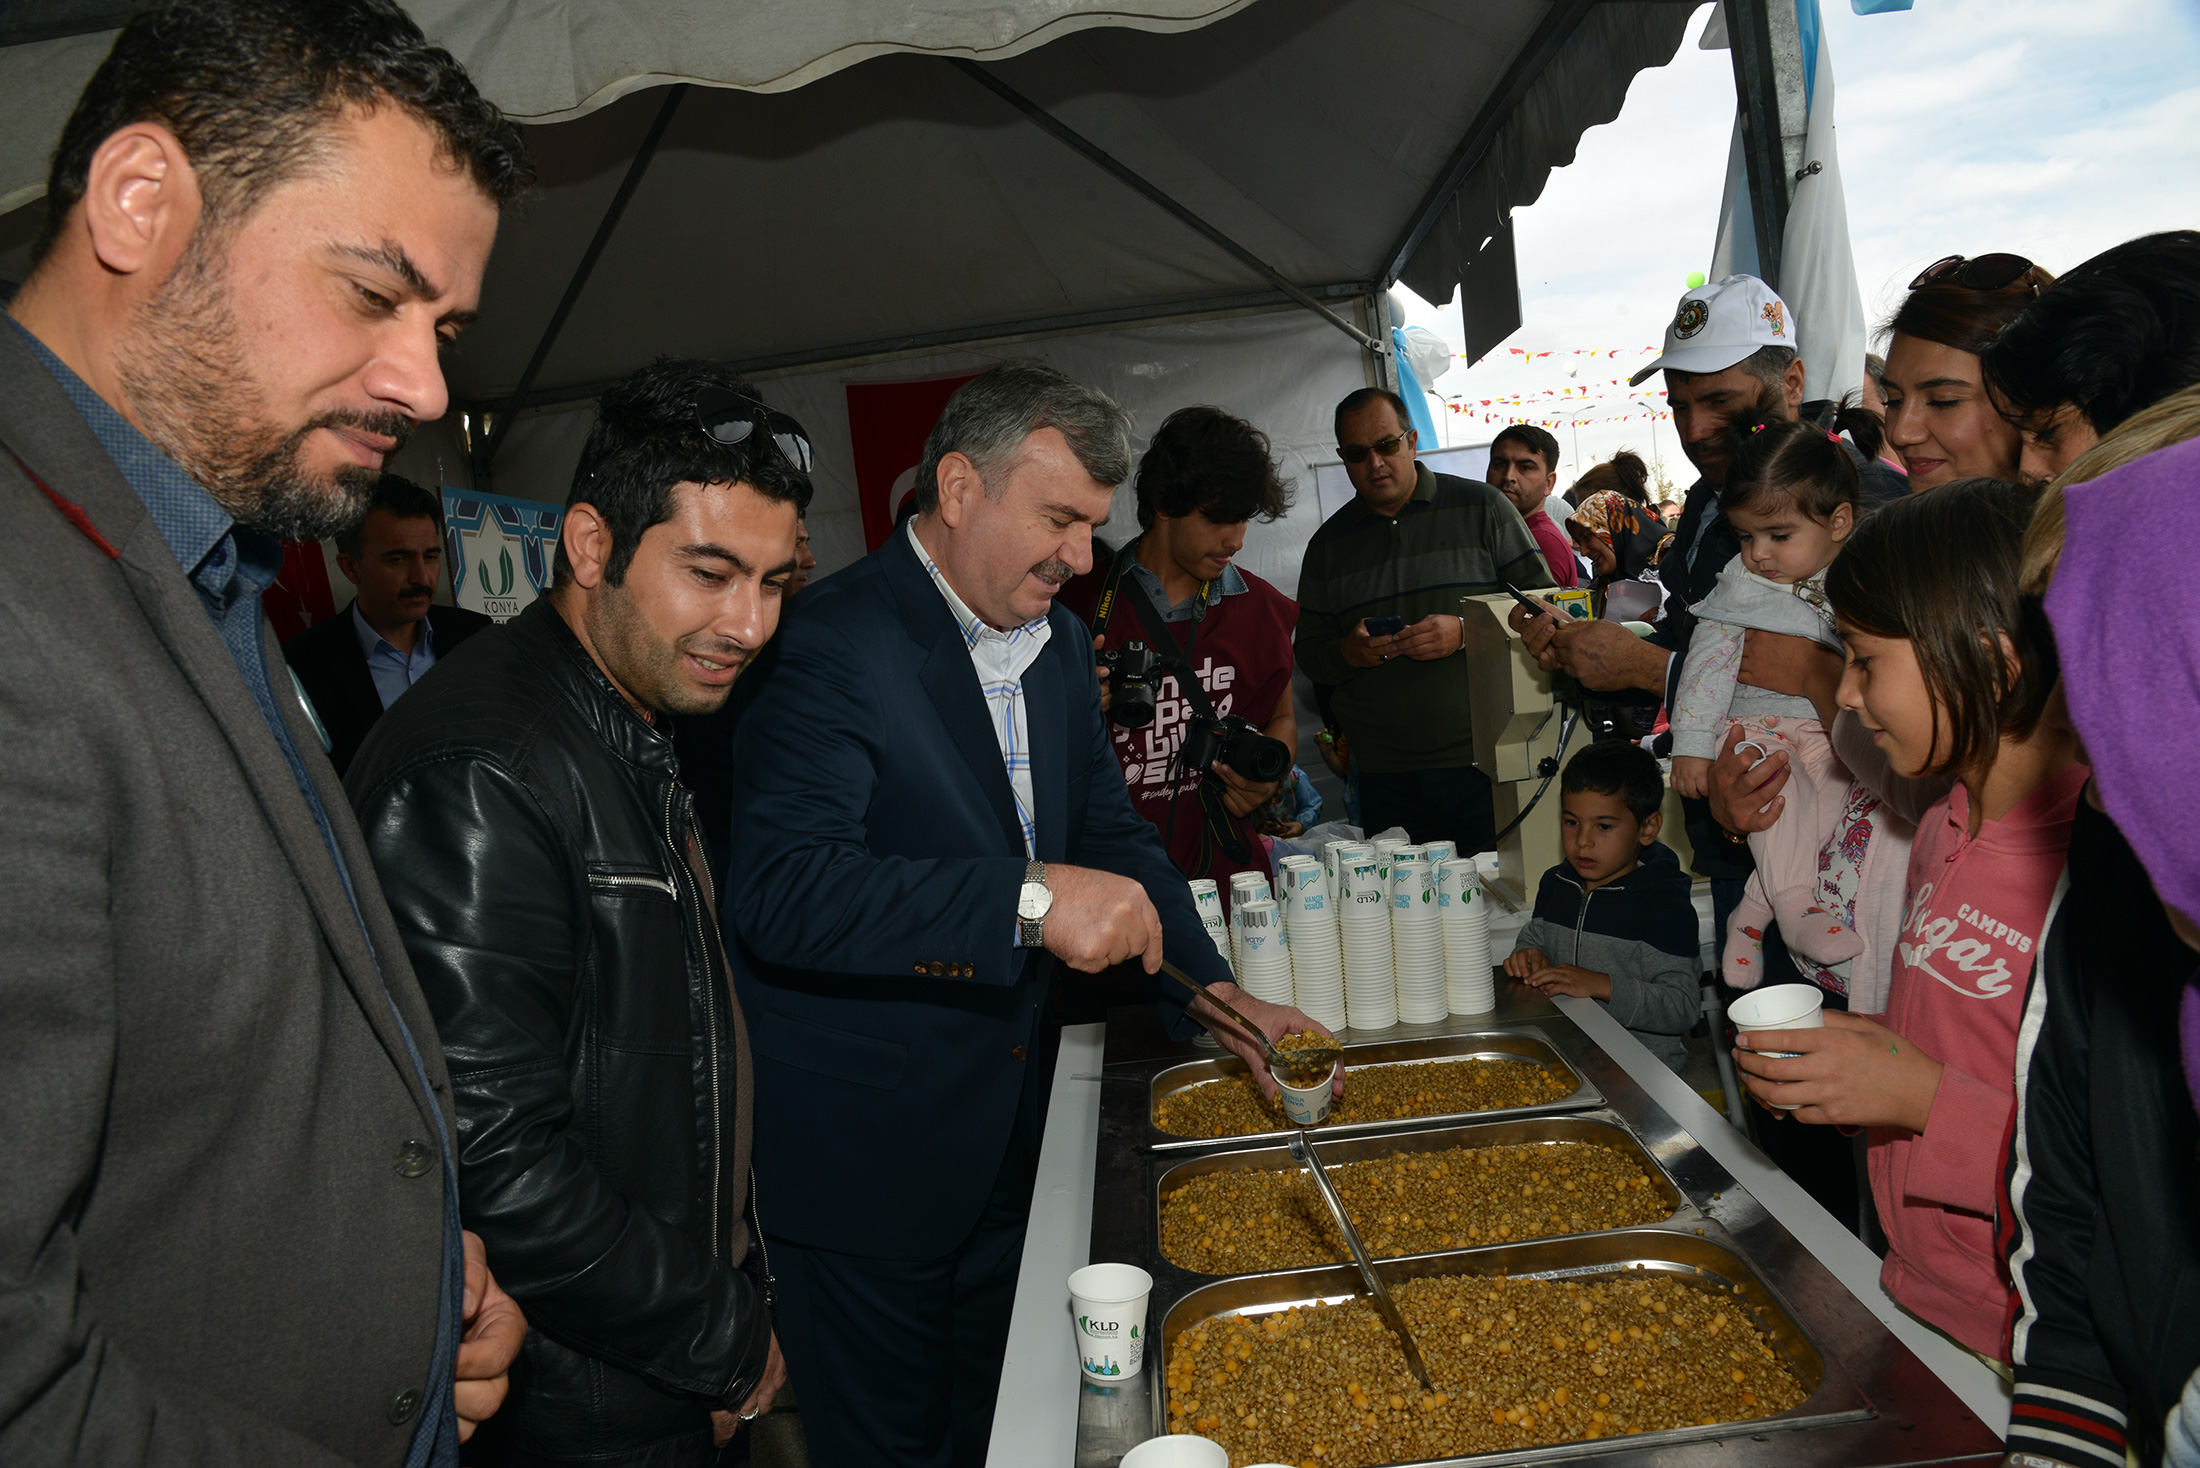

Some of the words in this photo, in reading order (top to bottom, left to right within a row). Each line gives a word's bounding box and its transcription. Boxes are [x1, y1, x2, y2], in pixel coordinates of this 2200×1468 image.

[483, 601, 520, 614] KONYA
[1098, 590, 1113, 618] Nikon
[1303, 894, 1324, 903] KONYA
[1356, 895, 1376, 904] KLD
[1303, 901, 1324, 911] BORSA
[1957, 903, 2033, 954] CAMPUS
[1089, 1320, 1119, 1331] KLD
